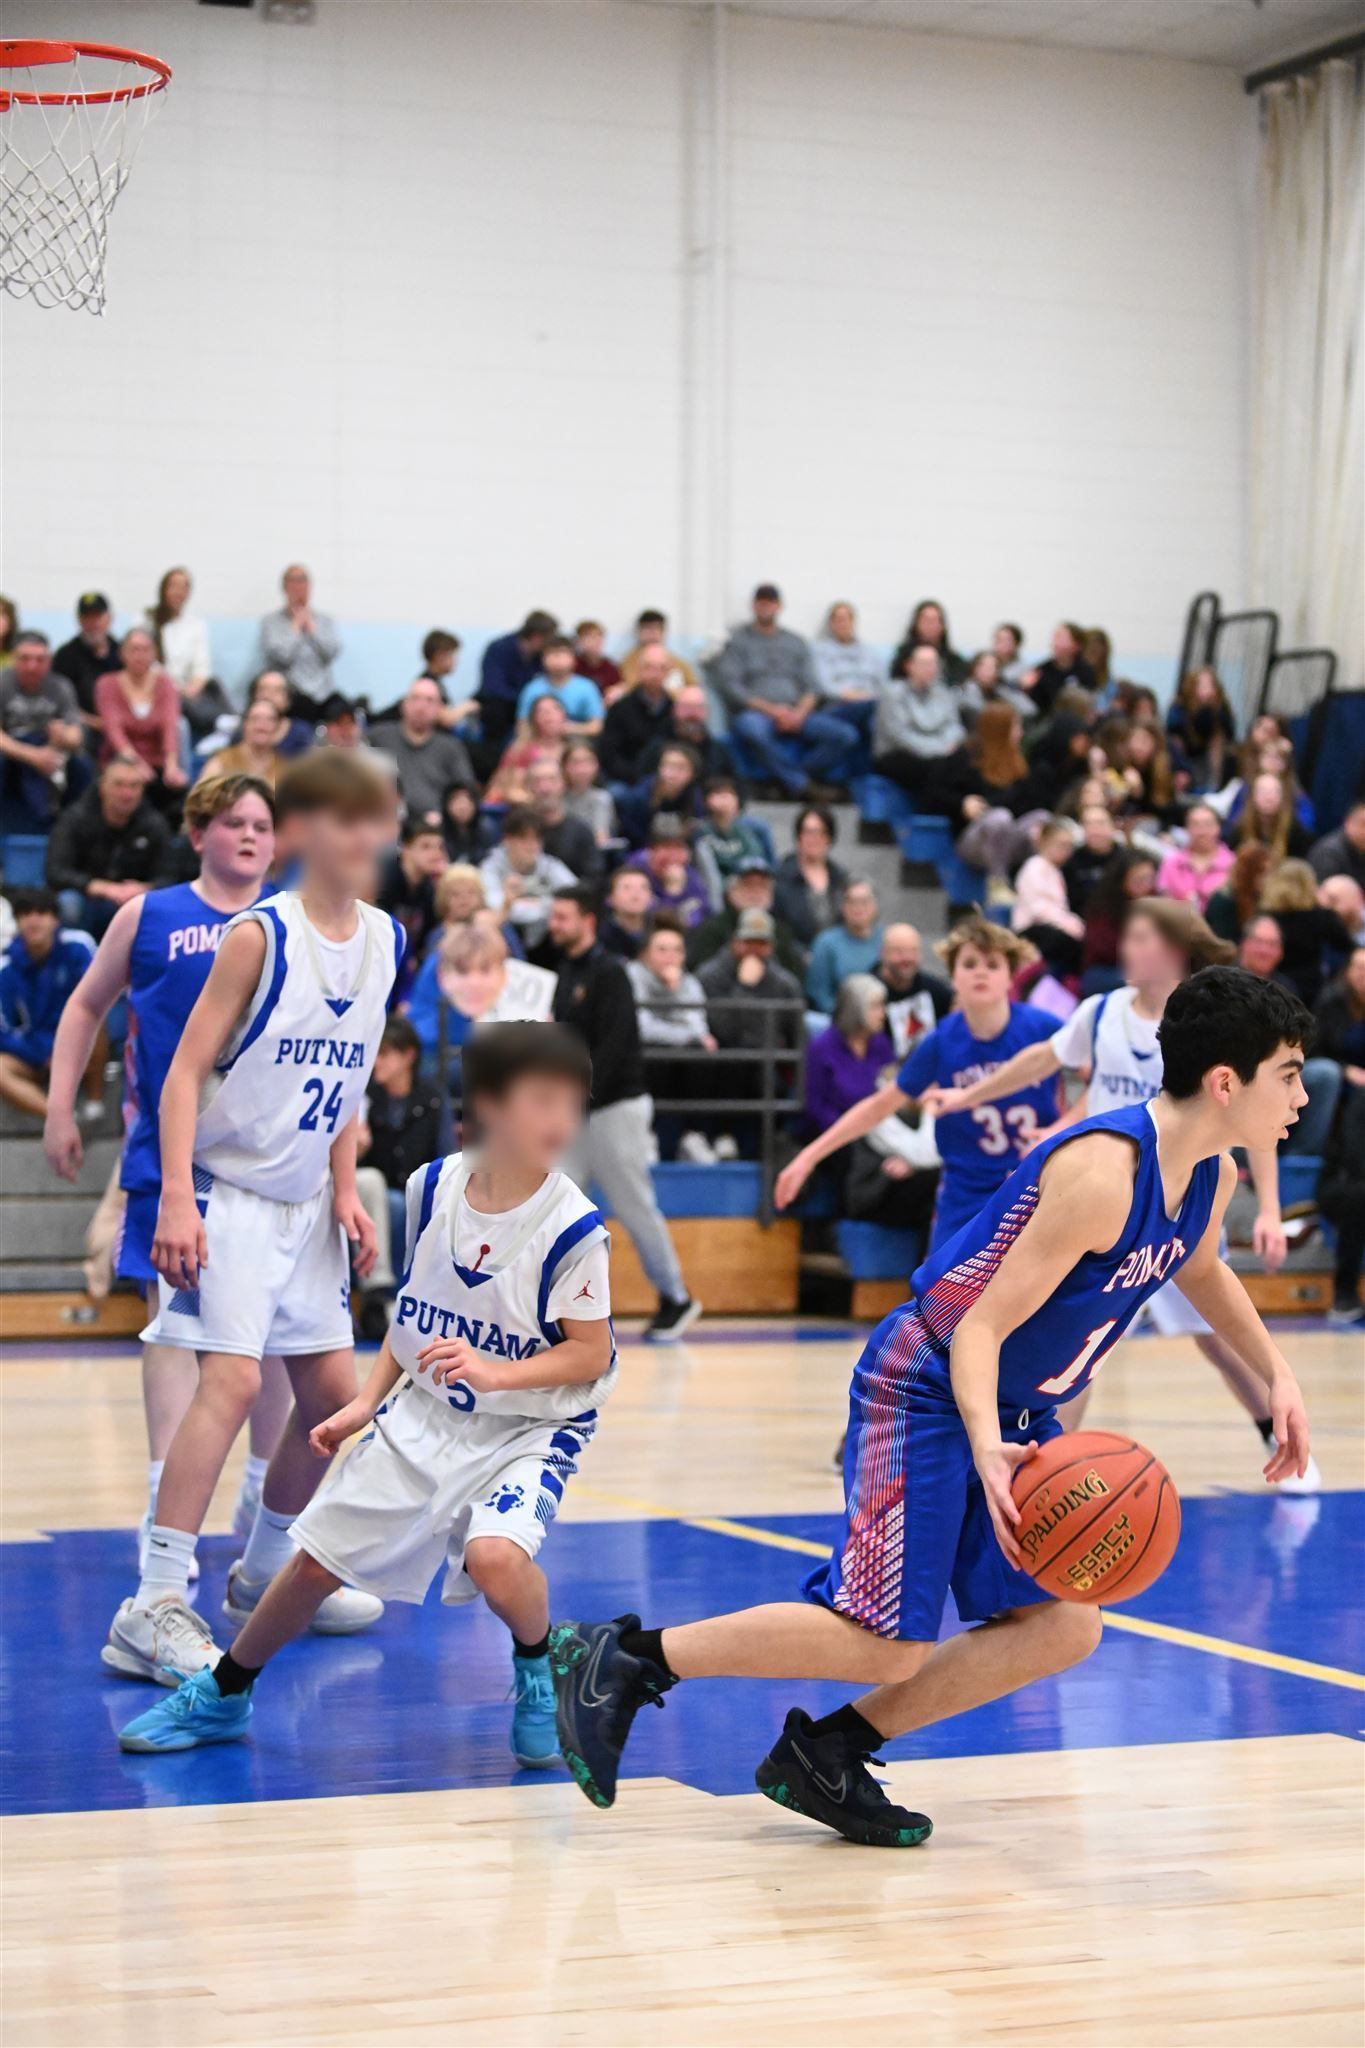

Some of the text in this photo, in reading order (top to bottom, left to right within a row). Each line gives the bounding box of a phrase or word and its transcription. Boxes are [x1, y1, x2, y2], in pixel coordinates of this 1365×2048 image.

[168, 923, 223, 961] POM
[274, 1038, 365, 1069] PUTNA
[298, 1077, 344, 1133] 24
[971, 1104, 1038, 1155] 33
[396, 1295, 541, 1361] PUTNAM
[1020, 1469, 1108, 1563] SPALDING
[1056, 1513, 1129, 1587] LEGACY
